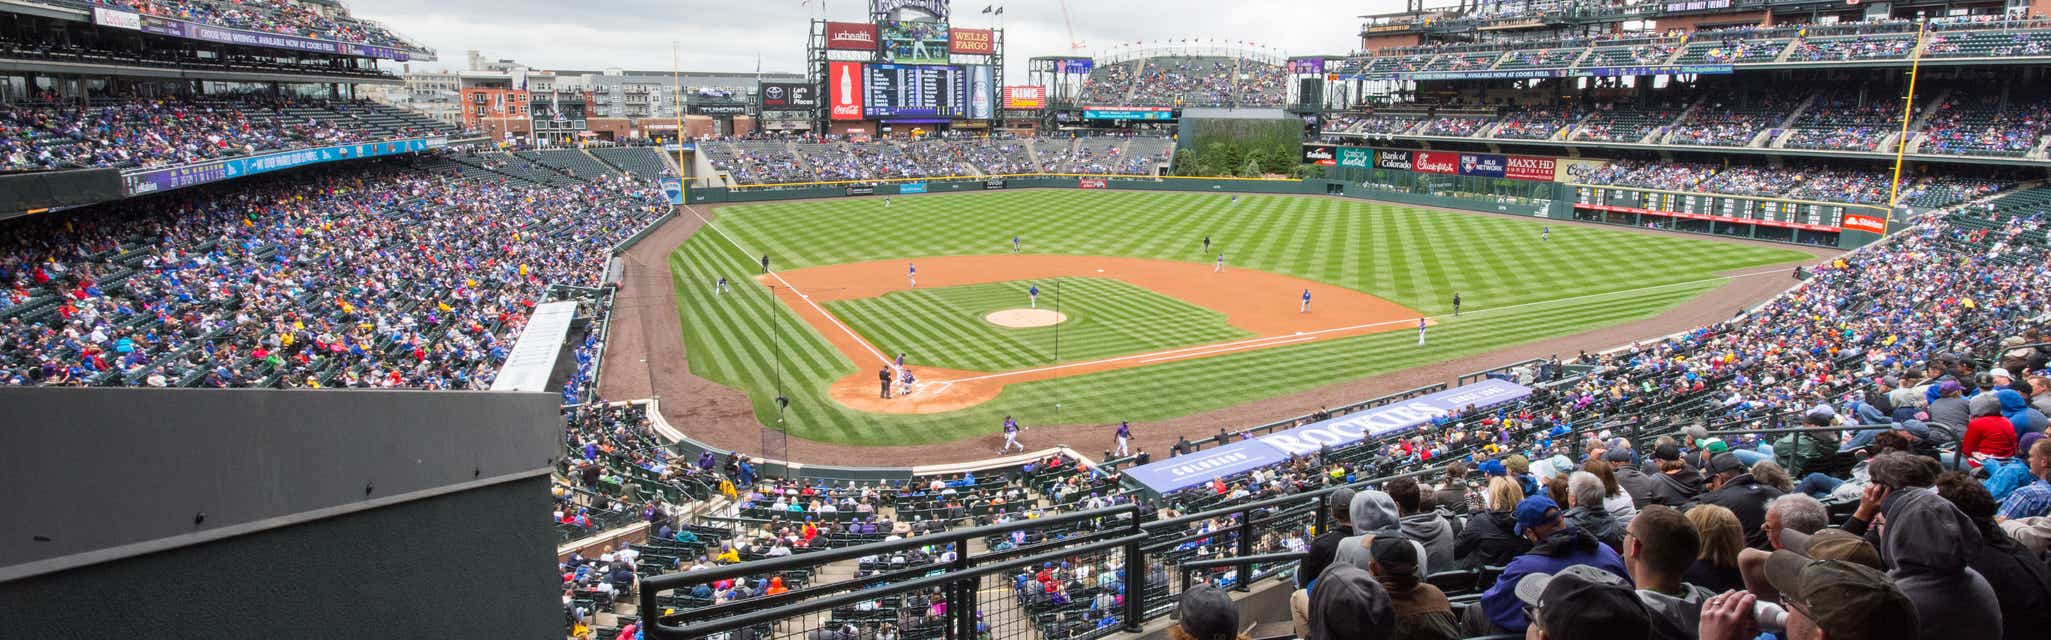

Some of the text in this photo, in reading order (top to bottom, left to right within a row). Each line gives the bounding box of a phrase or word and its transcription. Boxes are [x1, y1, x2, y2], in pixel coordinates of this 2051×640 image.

[834, 31, 870, 40] uchealth
[954, 31, 988, 41] WELLS
[955, 41, 988, 50] FARGO
[1382, 152, 1407, 160] Bank of
[1381, 160, 1411, 169] Colorado
[1507, 158, 1554, 169] MAXX HD
[1260, 402, 1448, 456] ROCKIES
[1171, 452, 1248, 476] COLORADO
